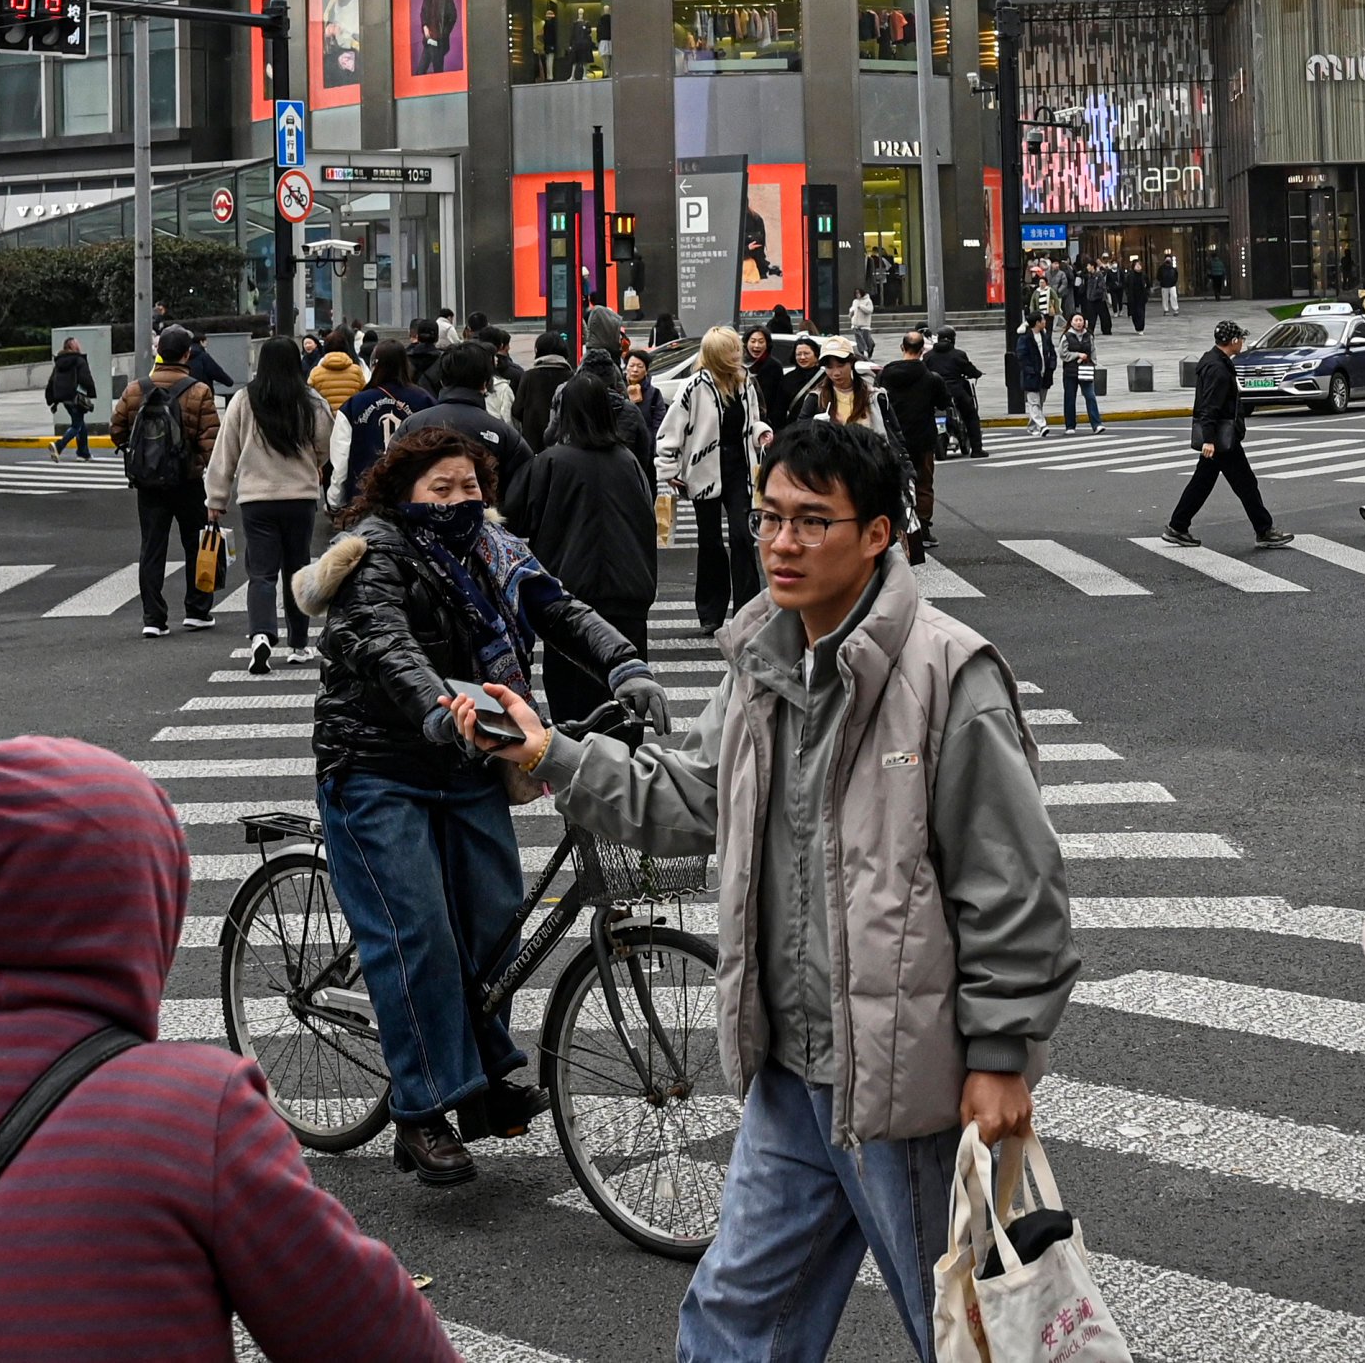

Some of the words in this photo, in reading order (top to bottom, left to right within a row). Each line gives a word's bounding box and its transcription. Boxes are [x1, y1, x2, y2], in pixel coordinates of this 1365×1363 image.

[287, 128, 295, 162] 单行道
[407, 169, 419, 181] 10
[686, 201, 702, 229] P
[1041, 1296, 1094, 1352] 安若澜
